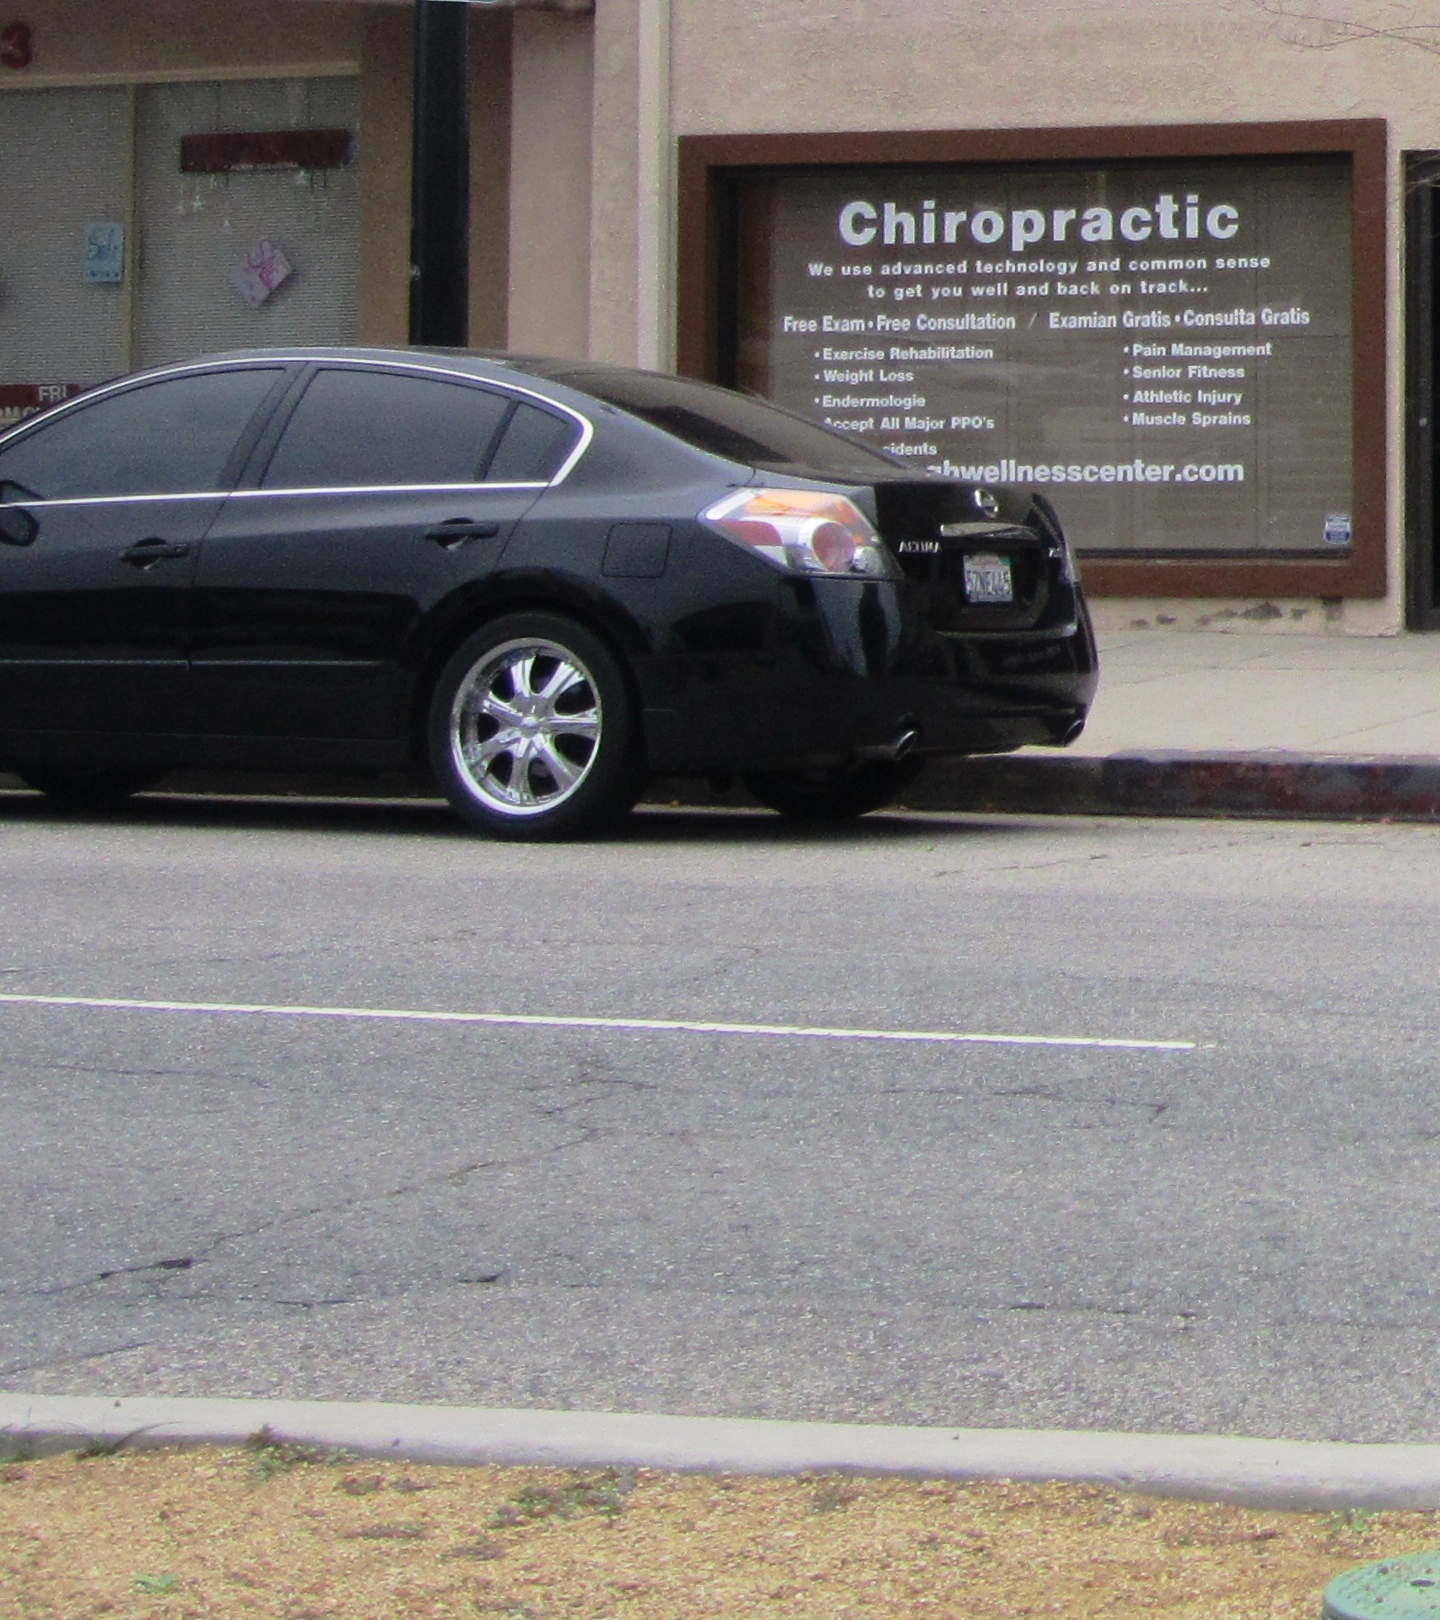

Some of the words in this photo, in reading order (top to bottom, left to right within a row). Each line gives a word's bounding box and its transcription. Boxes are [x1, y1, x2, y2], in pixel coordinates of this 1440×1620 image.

[839, 194, 1240, 252] Chiropractic
[808, 263, 833, 276] We
[841, 265, 872, 275] use
[881, 261, 967, 275] advanced
[975, 260, 1078, 276] technology
[1087, 258, 1120, 271] and
[1129, 259, 1207, 270] common
[1215, 257, 1271, 268] sense
[867, 284, 885, 298] to
[893, 284, 923, 300] get
[931, 286, 963, 300] you
[972, 283, 1008, 296] well
[1016, 283, 1049, 296] and
[1057, 281, 1101, 295] back
[1110, 283, 1131, 294] on
[1140, 280, 1208, 294] track...
[784, 316, 818, 332] Free
[822, 315, 866, 332] Exam
[876, 314, 911, 331] Free
[916, 313, 1016, 330] Consultation
[1049, 311, 1117, 329] Examian
[1123, 310, 1171, 328] Gratis
[1183, 308, 1256, 327] Consulta
[1261, 308, 1310, 326] Gratis
[823, 348, 885, 361] Exercise
[890, 346, 993, 360] Rehabilitation
[1133, 344, 1166, 356] Pain
[1171, 342, 1273, 358] Management
[824, 369, 874, 385] Weight
[879, 369, 914, 382] Loss
[1133, 366, 1182, 378] Senior
[1188, 366, 1245, 378] Fitness
[822, 395, 926, 410] Endermologie
[1133, 390, 1192, 403] Athletic
[1197, 390, 1243, 405] Injury
[880, 416, 900, 429] All
[904, 416, 946, 431] Major
[951, 416, 995, 429] PPO's
[1132, 412, 1186, 425] Muscle
[1192, 412, 1251, 428] Sprains
